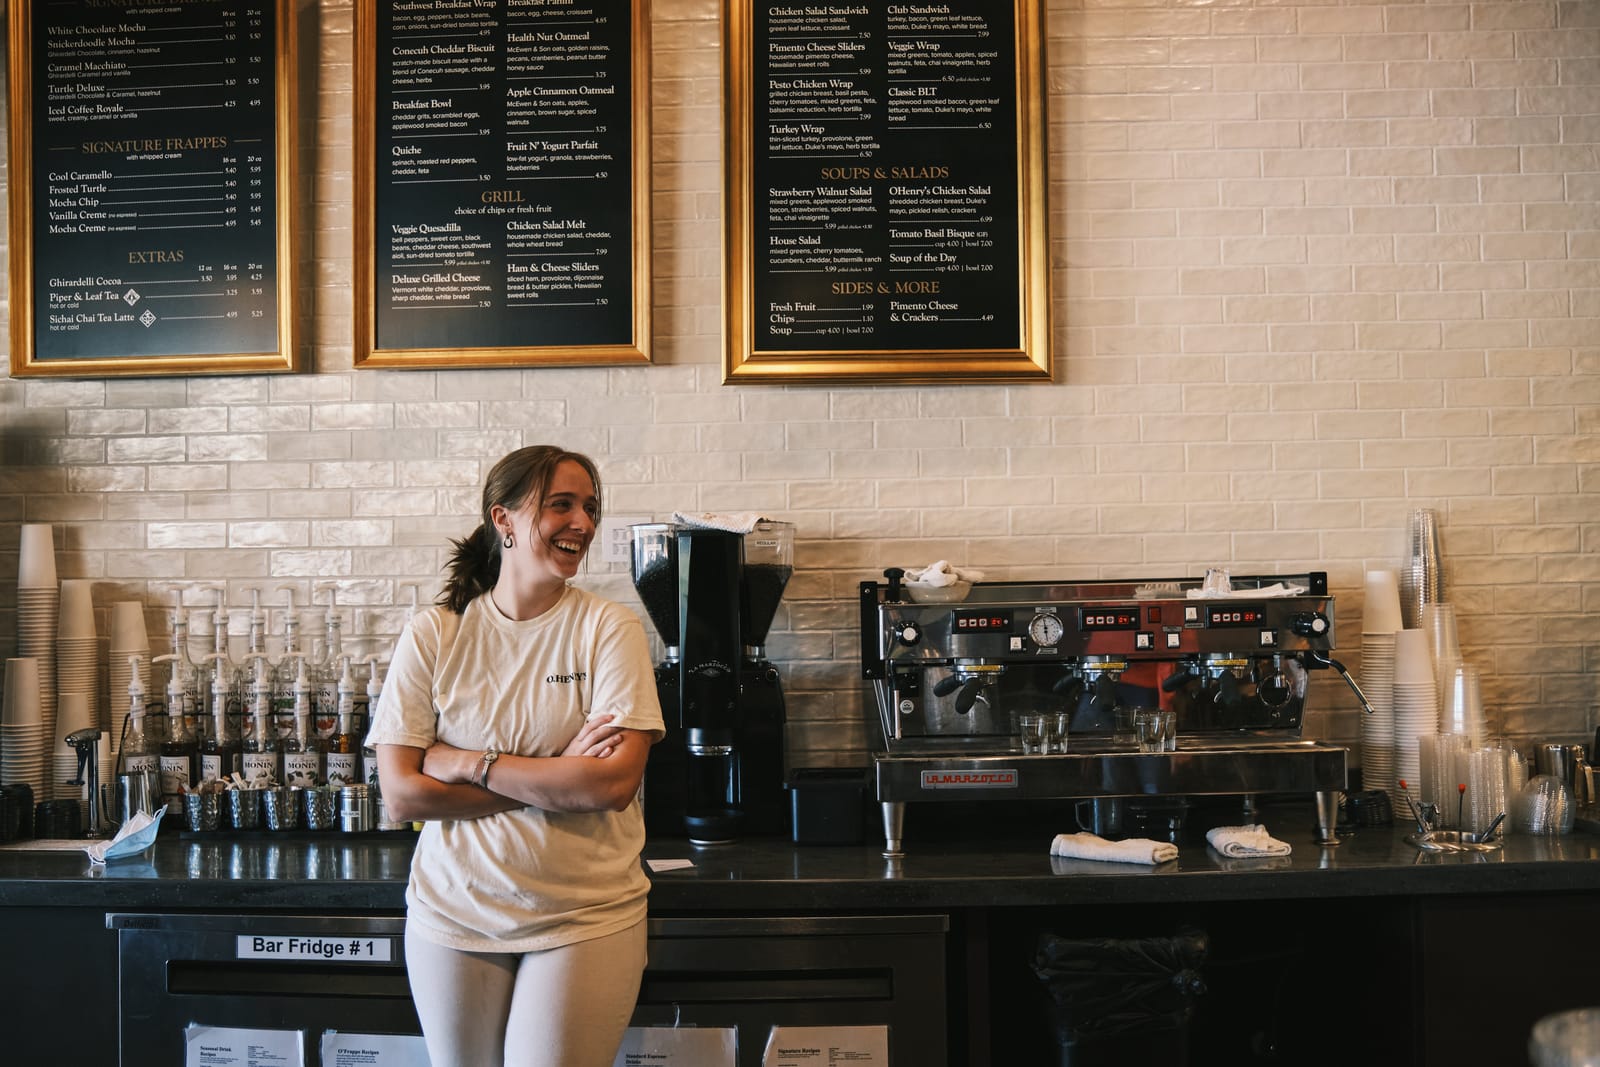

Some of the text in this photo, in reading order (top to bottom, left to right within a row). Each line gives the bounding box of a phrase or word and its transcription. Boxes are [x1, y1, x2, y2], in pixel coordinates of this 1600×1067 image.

[392, 0, 497, 10] Southwest Breakfast Wrap
[768, 5, 869, 16] Chicken Salad Sandwich
[887, 4, 950, 14] Club Sandwich
[47, 23, 146, 35] White Chocolate Mocha
[507, 31, 590, 42] Health Nut Oatmeal
[47, 37, 136, 48] Snickerdoodle Mocha
[769, 41, 866, 52] Pimento Cheese Sliders
[887, 41, 940, 52] Veggie Wrap
[392, 43, 495, 56] Conecuh Cheddar Biscuit
[47, 60, 127, 72] Caramel Macchiato
[47, 83, 105, 93] Turtle Deluxe
[768, 79, 854, 89] Pesto Chicken Wrap
[506, 85, 615, 98] Apple Cinnamon Oatmeal
[887, 87, 937, 96] Classic BLT
[48, 103, 124, 115] Iced Coffee Royale
[392, 98, 452, 110] Breakfast Bowl
[768, 124, 825, 135] Turkey Wrap
[82, 136, 227, 153] SIGNATURE FRAPPES
[507, 140, 598, 152] Fruit N' Yogurt Parfait
[768, 143, 781, 151] leaf
[391, 145, 422, 156] Quiche
[48, 170, 113, 181] Cool Caramello
[821, 166, 949, 180] SOUPS & SALADS
[49, 184, 107, 194] Frosted Turtle
[769, 186, 872, 197] Strawberry Walnut Salad
[888, 185, 991, 196] OHenry's Chicken Salad
[49, 197, 99, 207] Mocha Chip
[481, 190, 526, 203] GRILL
[49, 210, 78, 220] Vanilla
[79, 210, 107, 219] Creme
[454, 206, 477, 215] choice
[477, 206, 486, 214] of
[486, 205, 506, 215] chips
[516, 205, 534, 213] fresh
[536, 204, 552, 213] fruit
[49, 224, 77, 233] Mocha
[78, 223, 106, 233] Creme
[391, 223, 461, 235] Veggie Quesadilla
[506, 219, 586, 230] Chicken Salad Melt
[888, 228, 975, 239] Tomato Basil Bisque
[769, 235, 821, 245] House Salad
[946, 239, 959, 247] 4.00
[965, 239, 979, 247] bowl
[980, 239, 993, 247] 7.00
[128, 250, 184, 264] EXTRAS
[889, 252, 957, 264] Soup of the Day
[507, 262, 599, 273] Ham & Cheese Sliders
[49, 276, 122, 287] Ghirardelli Cocoa
[392, 273, 481, 284] Deluxe Grilled Cheese
[831, 281, 940, 294] SIDES & MORE
[49, 290, 119, 303] Piper & Leaf Tea
[66, 301, 80, 309] cold
[770, 301, 874, 311] Fresh Fruit 1.99
[889, 300, 959, 310] Pimento Cheese
[49, 312, 135, 324] Sichai Chai Tea Latte
[769, 313, 795, 324] Chips
[889, 312, 939, 322] & Crackers
[769, 325, 793, 336] Soup
[253, 937, 374, 958] Bar Fridge # 1
